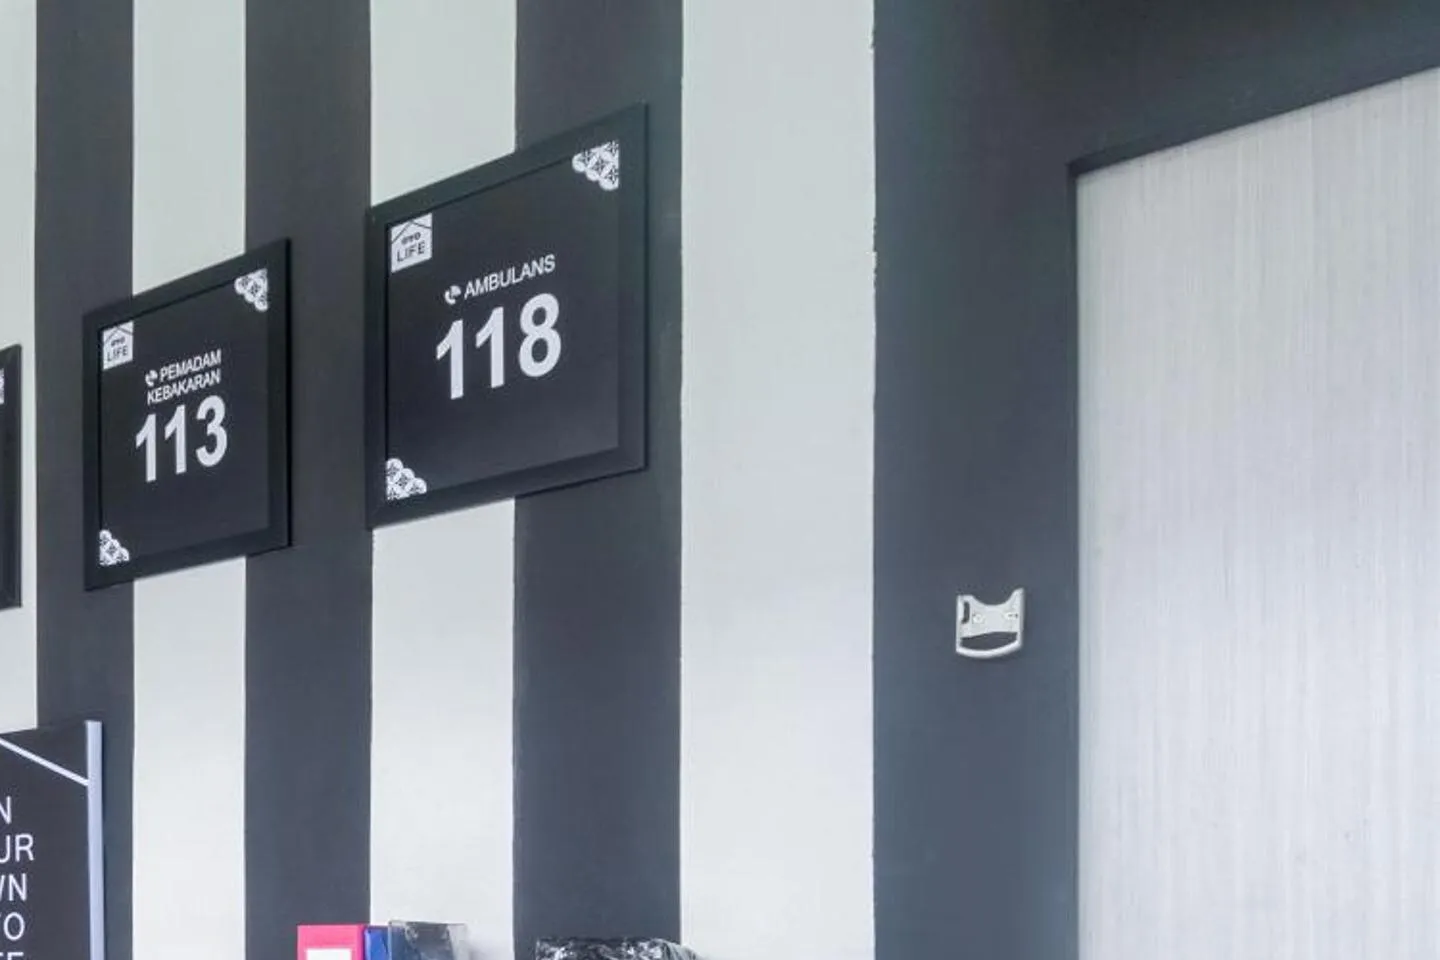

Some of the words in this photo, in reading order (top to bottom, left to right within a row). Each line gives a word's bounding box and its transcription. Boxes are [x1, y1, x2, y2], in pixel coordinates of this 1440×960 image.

[397, 241, 426, 261] LIFE
[464, 253, 556, 299] AMBULANS
[160, 349, 222, 382] PEMADAM
[436, 293, 562, 399] 118
[146, 368, 222, 404] KEBAKARAN
[135, 395, 228, 482] 113
